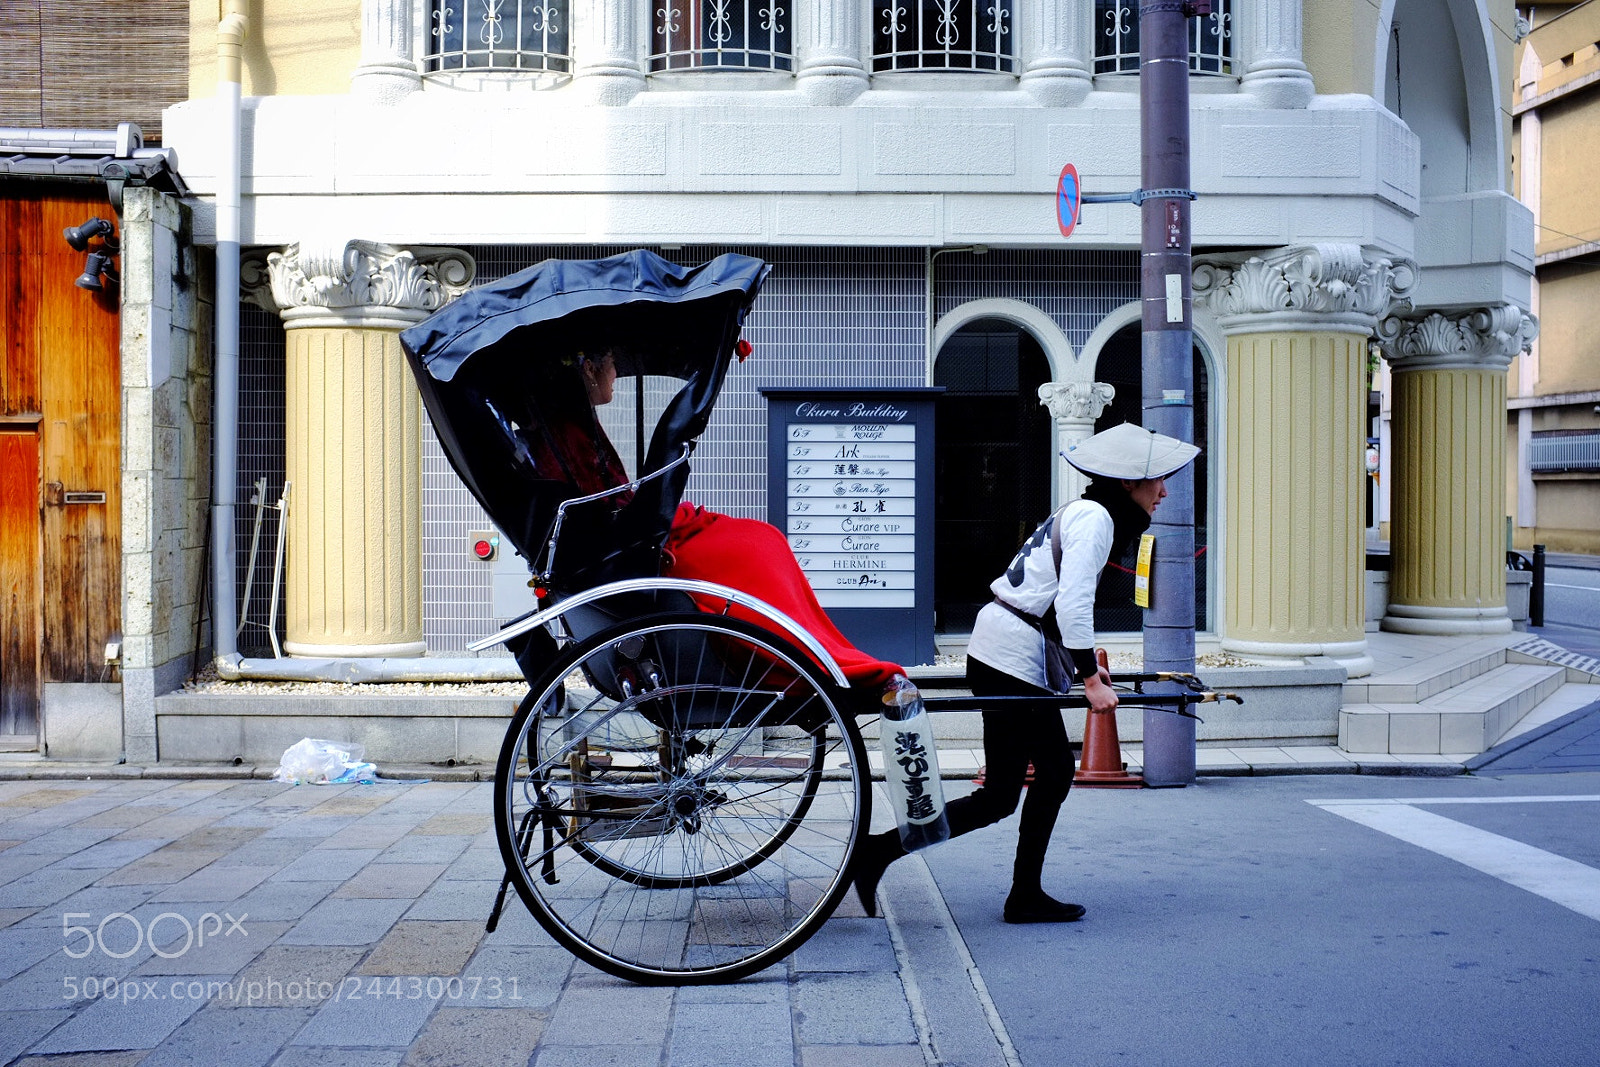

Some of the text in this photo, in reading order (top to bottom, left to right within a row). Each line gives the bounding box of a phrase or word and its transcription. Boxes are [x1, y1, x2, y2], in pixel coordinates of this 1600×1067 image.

[795, 402, 908, 421] Okura Building
[853, 432, 883, 440] ROUGE
[834, 444, 860, 458] Ark
[841, 517, 880, 532] Curare
[883, 524, 901, 532] VIP
[841, 535, 880, 551] Curare
[833, 560, 887, 569] HERMINE
